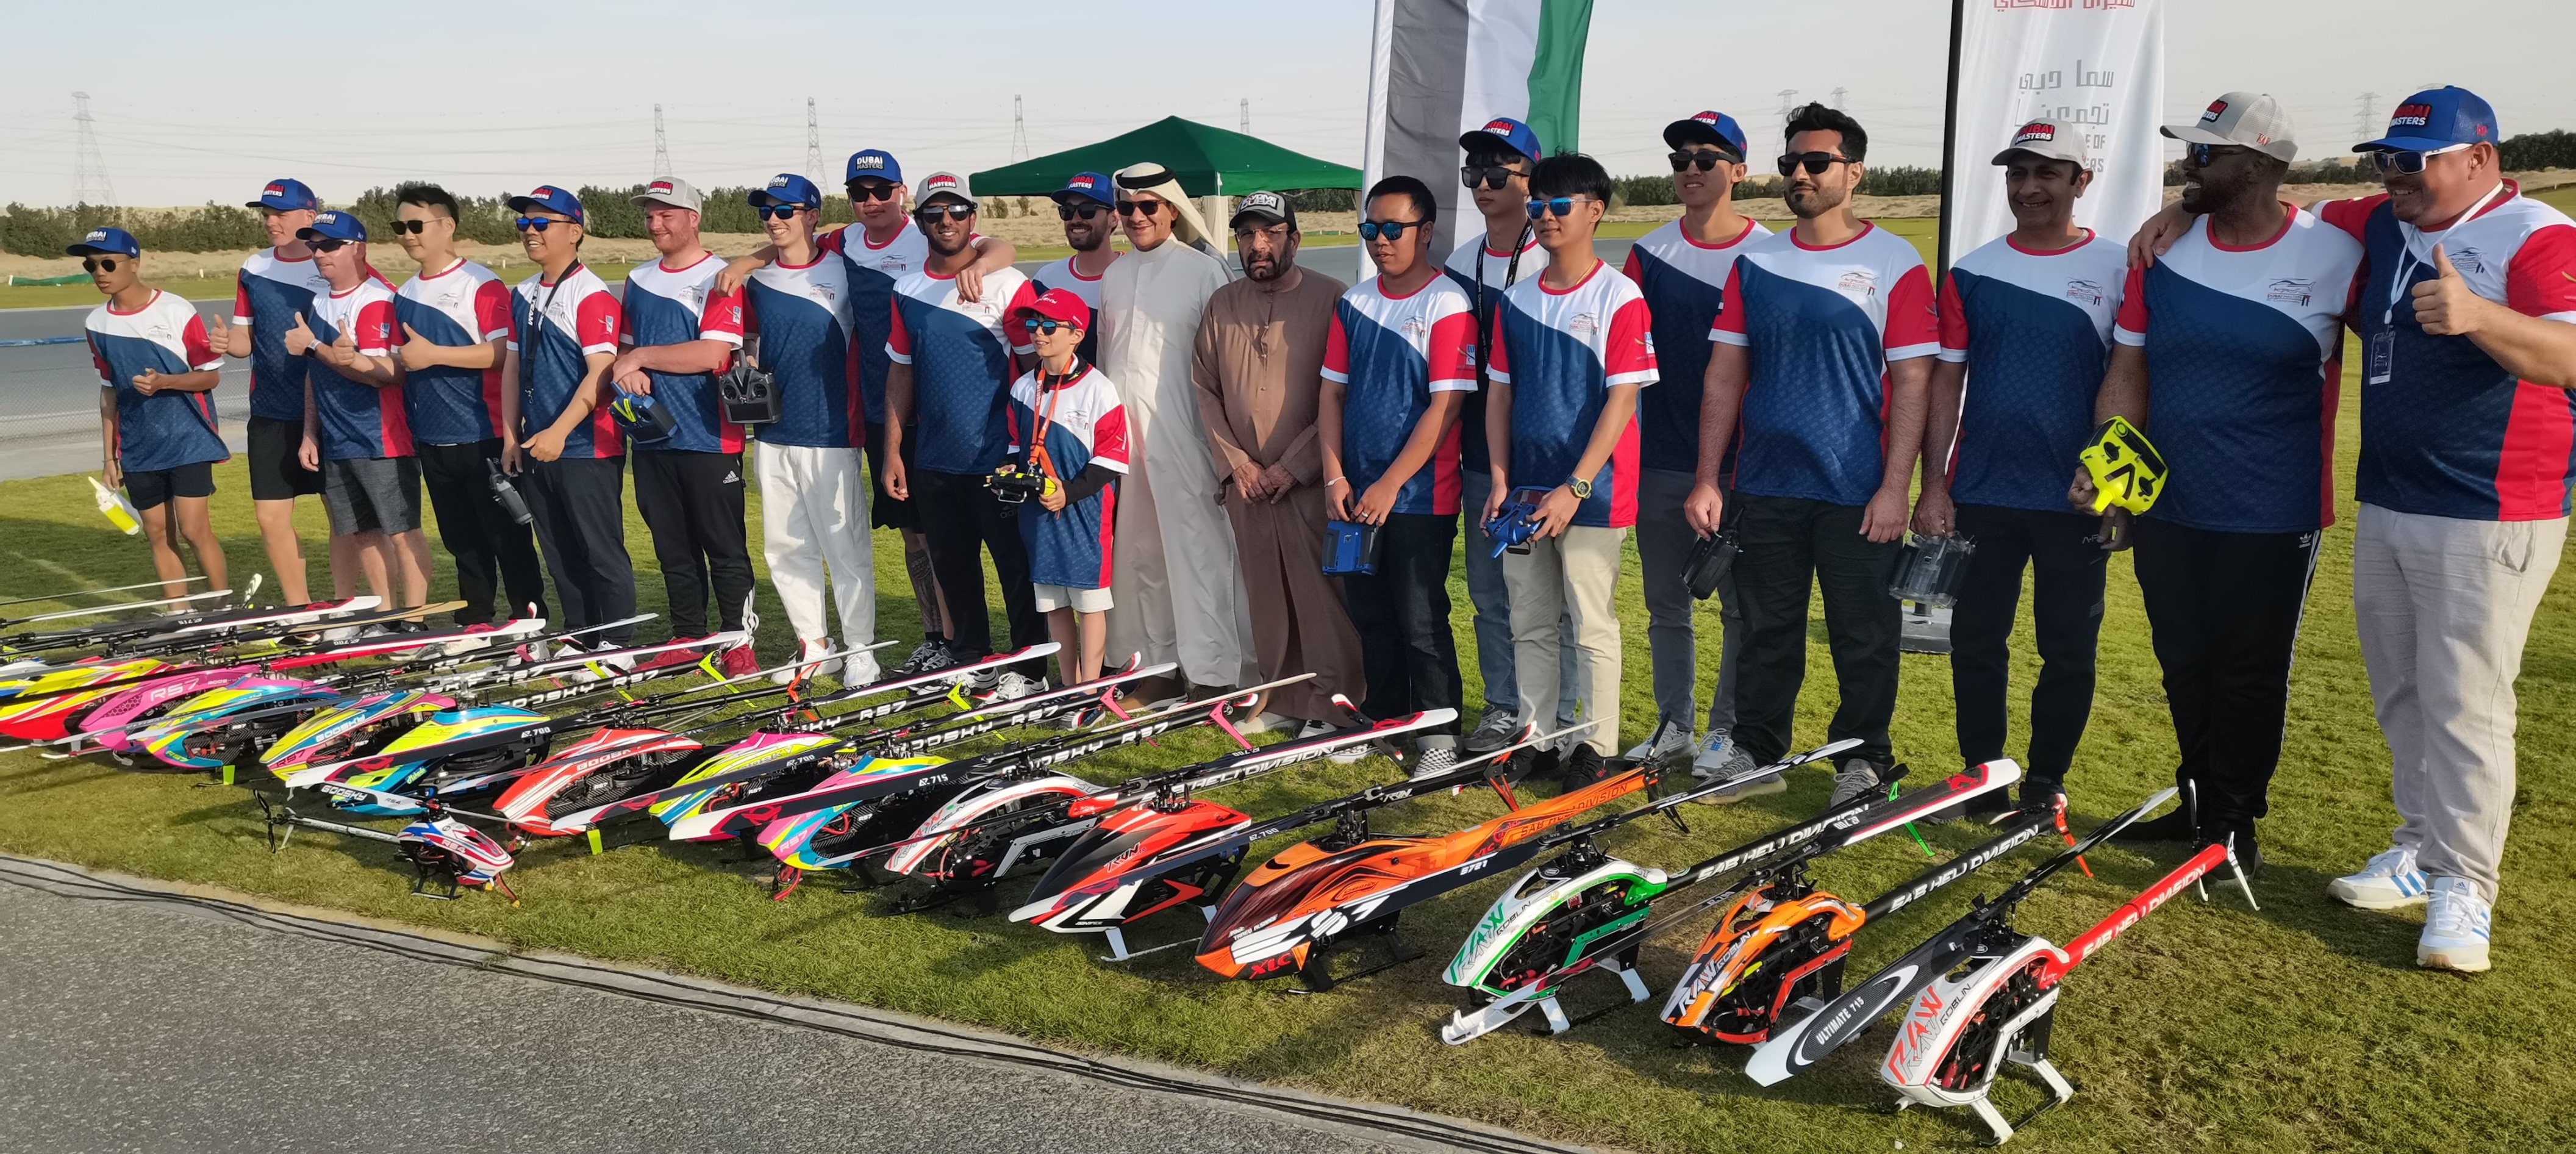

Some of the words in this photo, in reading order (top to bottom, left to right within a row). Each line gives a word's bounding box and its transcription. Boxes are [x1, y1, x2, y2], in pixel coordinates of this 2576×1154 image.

[857, 156, 883, 165] DUBAI
[929, 181, 956, 190] MASTERS
[528, 299, 537, 326] TEAM
[151, 678, 200, 702] RS7
[496, 668, 544, 684] RS7
[501, 684, 595, 708] OOSKY
[612, 670, 659, 688] RS7
[859, 701, 907, 721] RS7
[315, 714, 366, 744] GOOSKY
[911, 722, 993, 751] OOSKY
[1011, 704, 1059, 726] RS7
[1122, 722, 1169, 744] RS7
[277, 751, 306, 768] RS7
[1242, 747, 1336, 776] DIVISION
[321, 784, 368, 801] GOOSKY
[1520, 823, 1545, 837] SAB
[1580, 783, 1628, 810] DIVISION
[442, 839, 467, 853] RS4
[779, 829, 809, 853] RS7
[1695, 856, 1741, 884] SAB
[1742, 836, 1786, 864] HELI
[1888, 884, 1928, 914] SAB
[1930, 862, 1968, 893] HELI
[1969, 824, 2040, 871] DIVISION
[1496, 901, 1531, 936] GOBLIN
[2080, 929, 2113, 962] SAB
[2114, 906, 2147, 935] HELI
[2147, 863, 2206, 914] DIVISION
[1248, 952, 1292, 980] XLC
[1678, 956, 1720, 1017] RAW
[1717, 931, 1753, 969] GOBLIN
[1940, 983, 1972, 1027] GOBLIN
[1817, 1008, 1852, 1045] ULTIMATE
[1849, 996, 1865, 1012] 715
